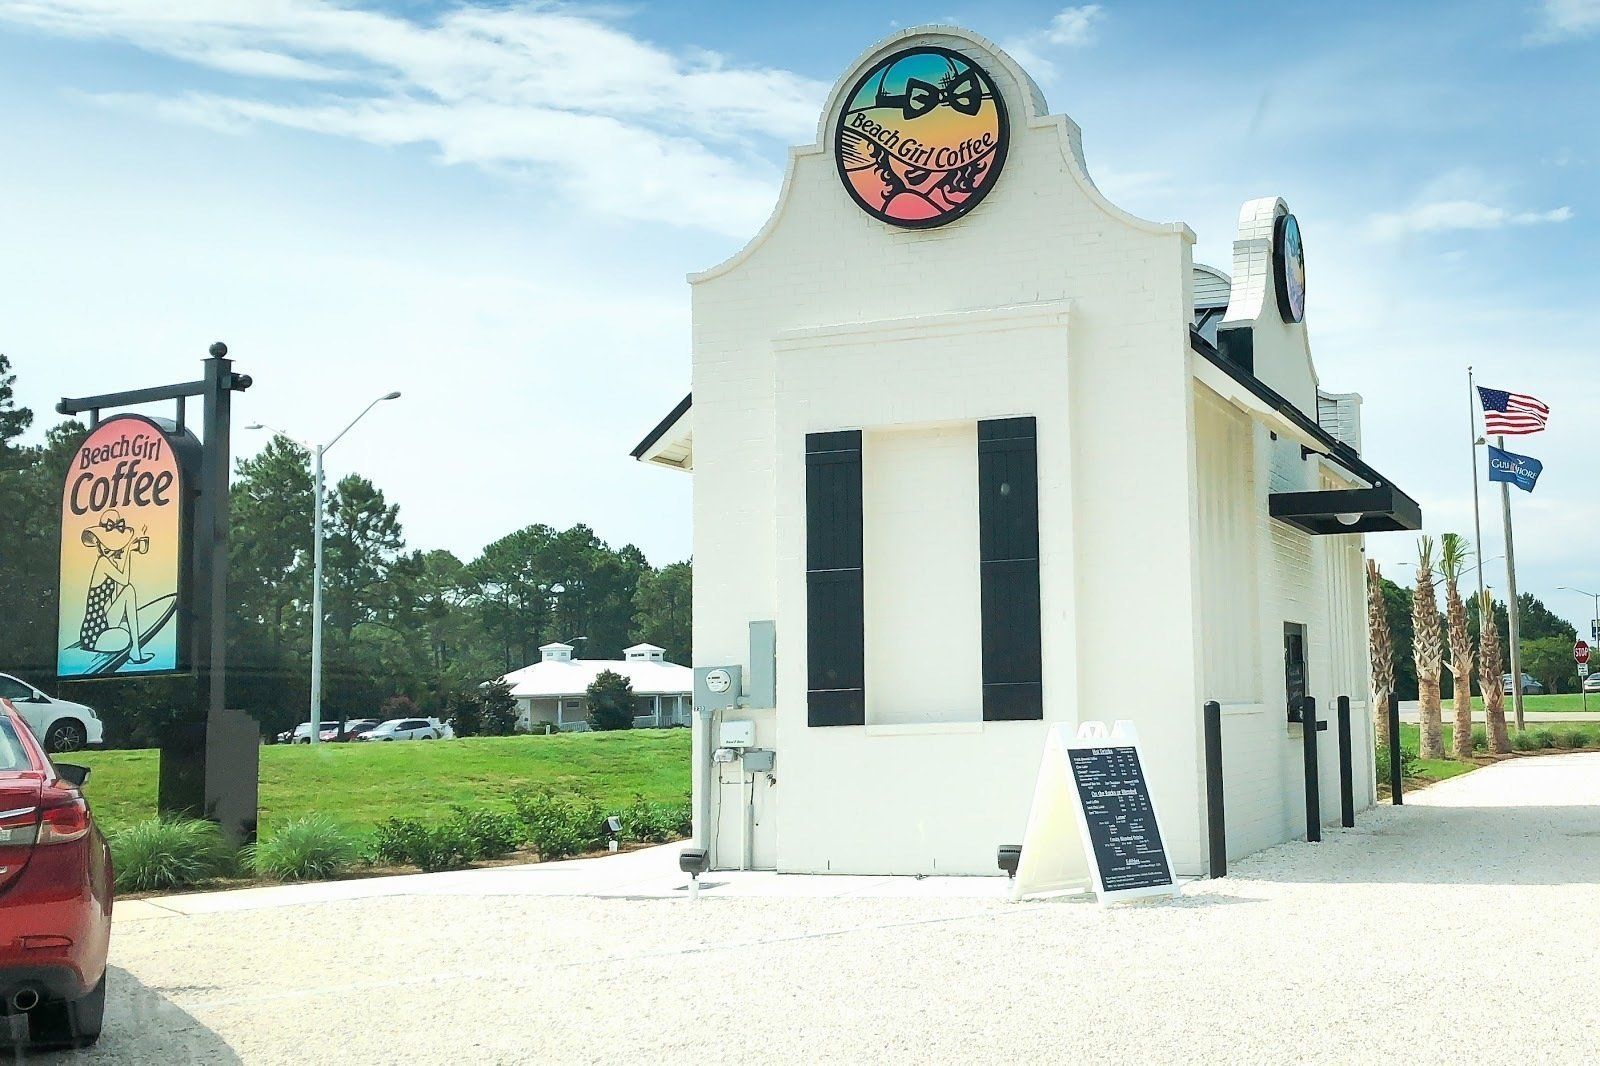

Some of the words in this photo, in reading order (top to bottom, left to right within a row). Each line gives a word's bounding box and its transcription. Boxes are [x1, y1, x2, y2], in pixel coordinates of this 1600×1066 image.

[850, 112, 900, 149] Beach
[897, 138, 936, 166] Girl
[935, 132, 994, 169] Coffee
[79, 434, 129, 470] Beach
[131, 434, 162, 461] Girl
[70, 459, 174, 516] Coffee
[1575, 647, 1588, 657] STOP
